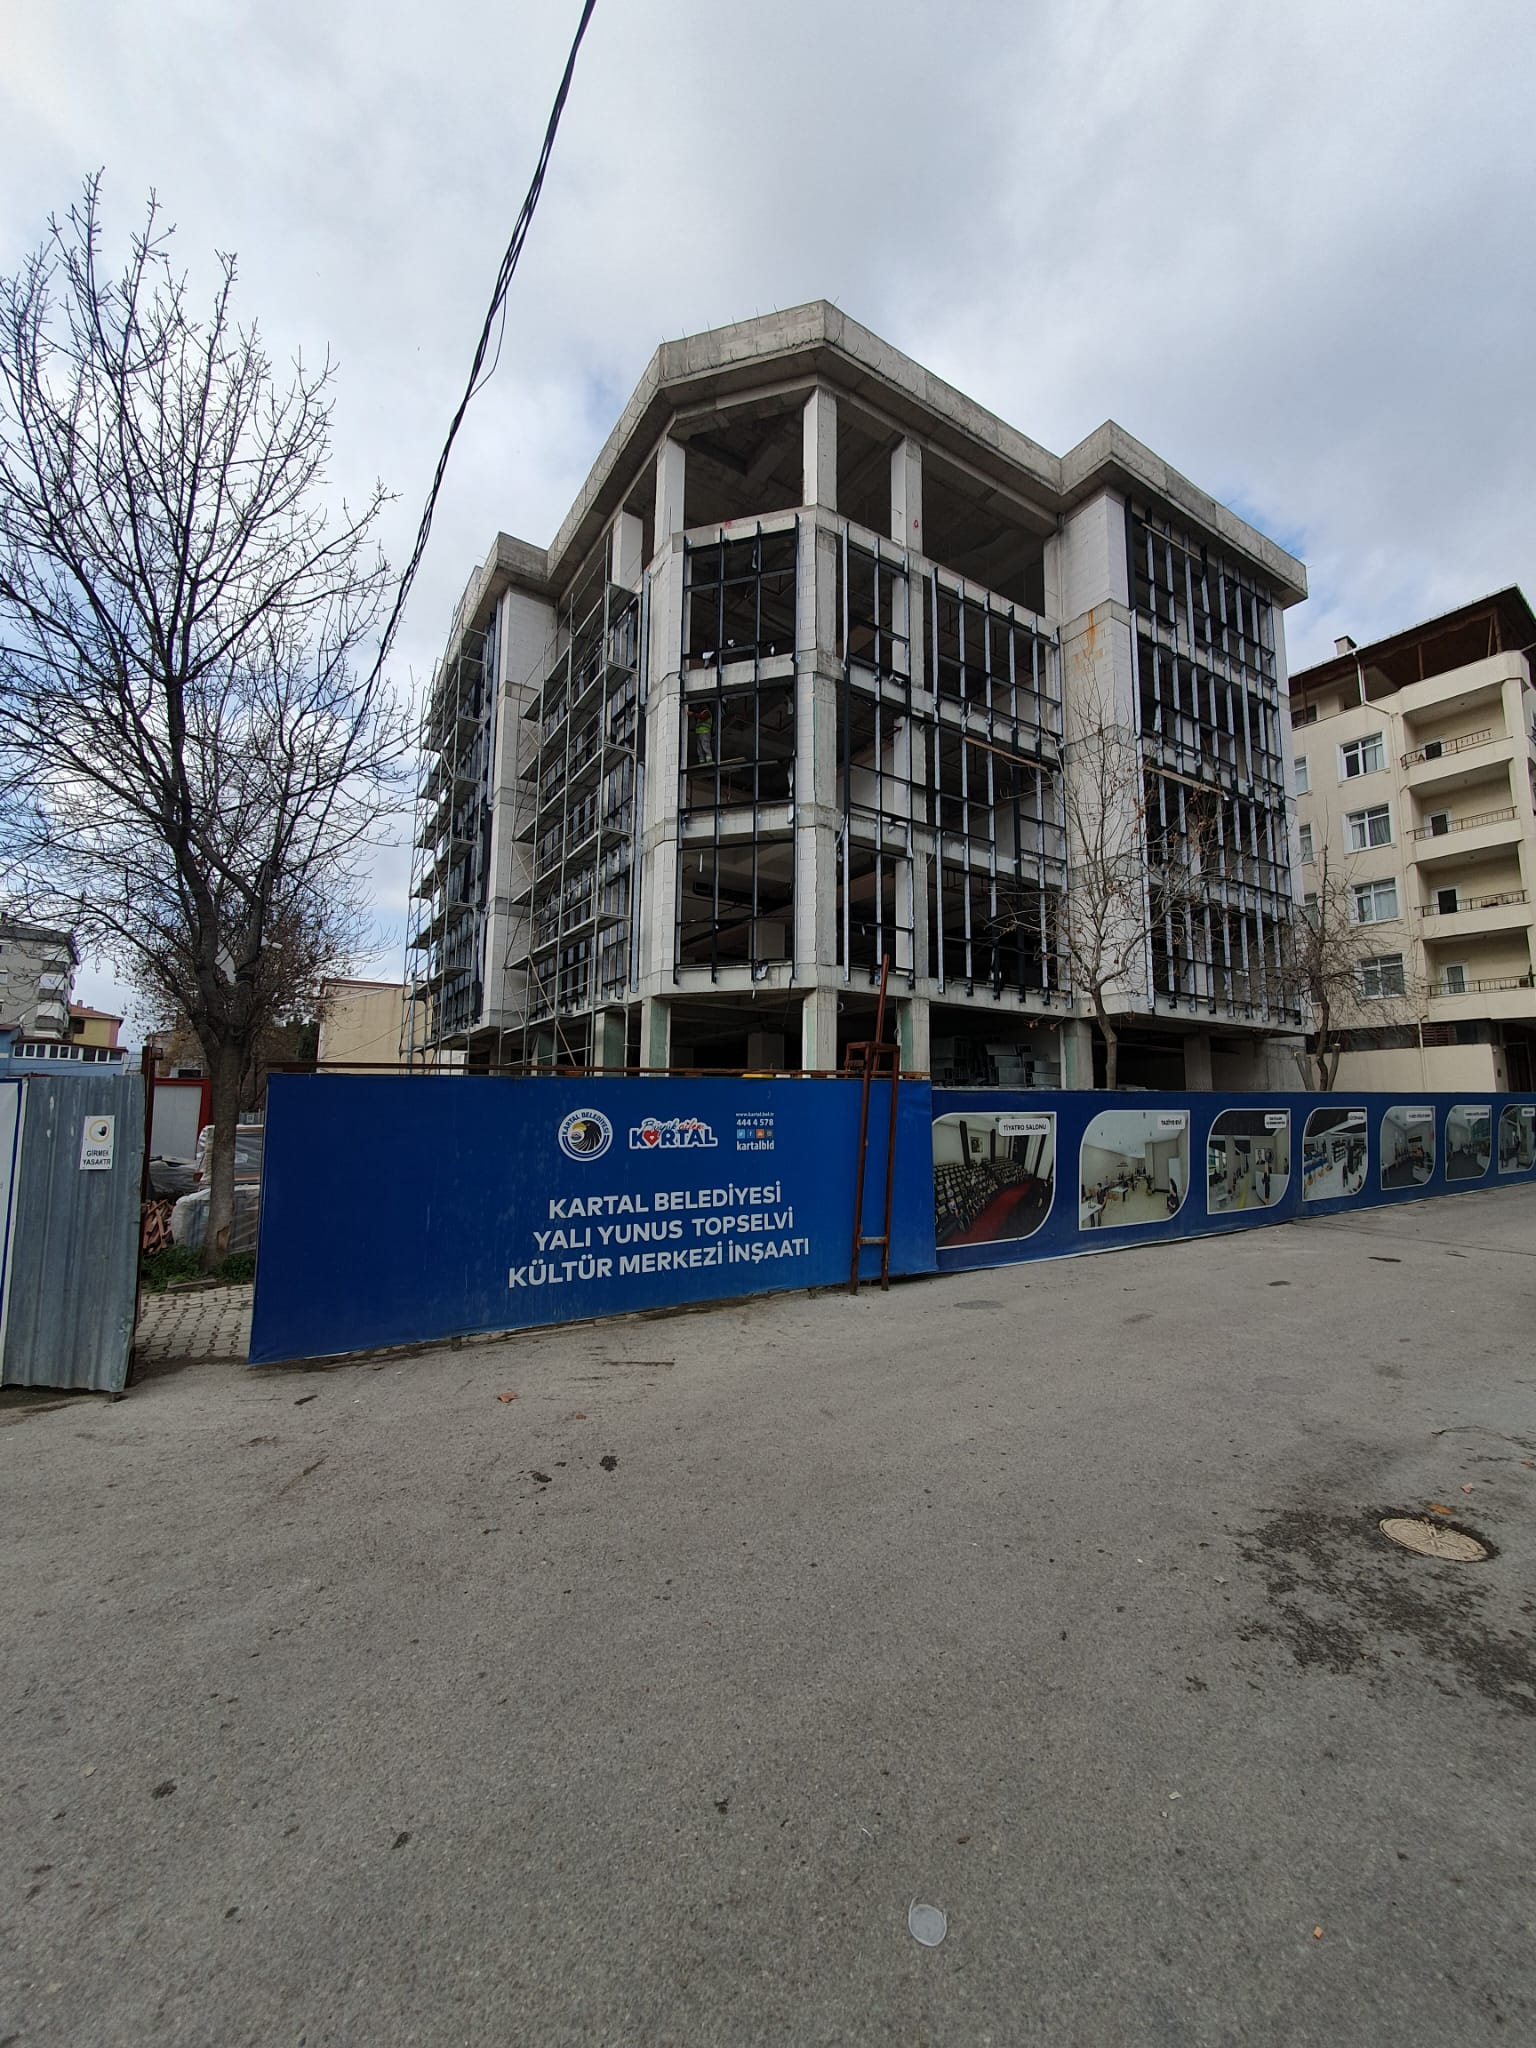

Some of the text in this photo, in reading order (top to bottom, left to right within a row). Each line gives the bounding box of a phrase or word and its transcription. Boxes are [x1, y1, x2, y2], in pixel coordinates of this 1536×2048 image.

[759, 1118, 774, 1126] 578
[1003, 1123, 1025, 1131] TİYATRO
[736, 1140, 774, 1151] kartalbld
[549, 1180, 782, 1220] KARTAL BELEDİYESİ
[533, 1205, 794, 1251] YALI YUNUS TOPSELVİ
[508, 1237, 810, 1289] KÜLTÜR MERKEZİ İNŞAATI
